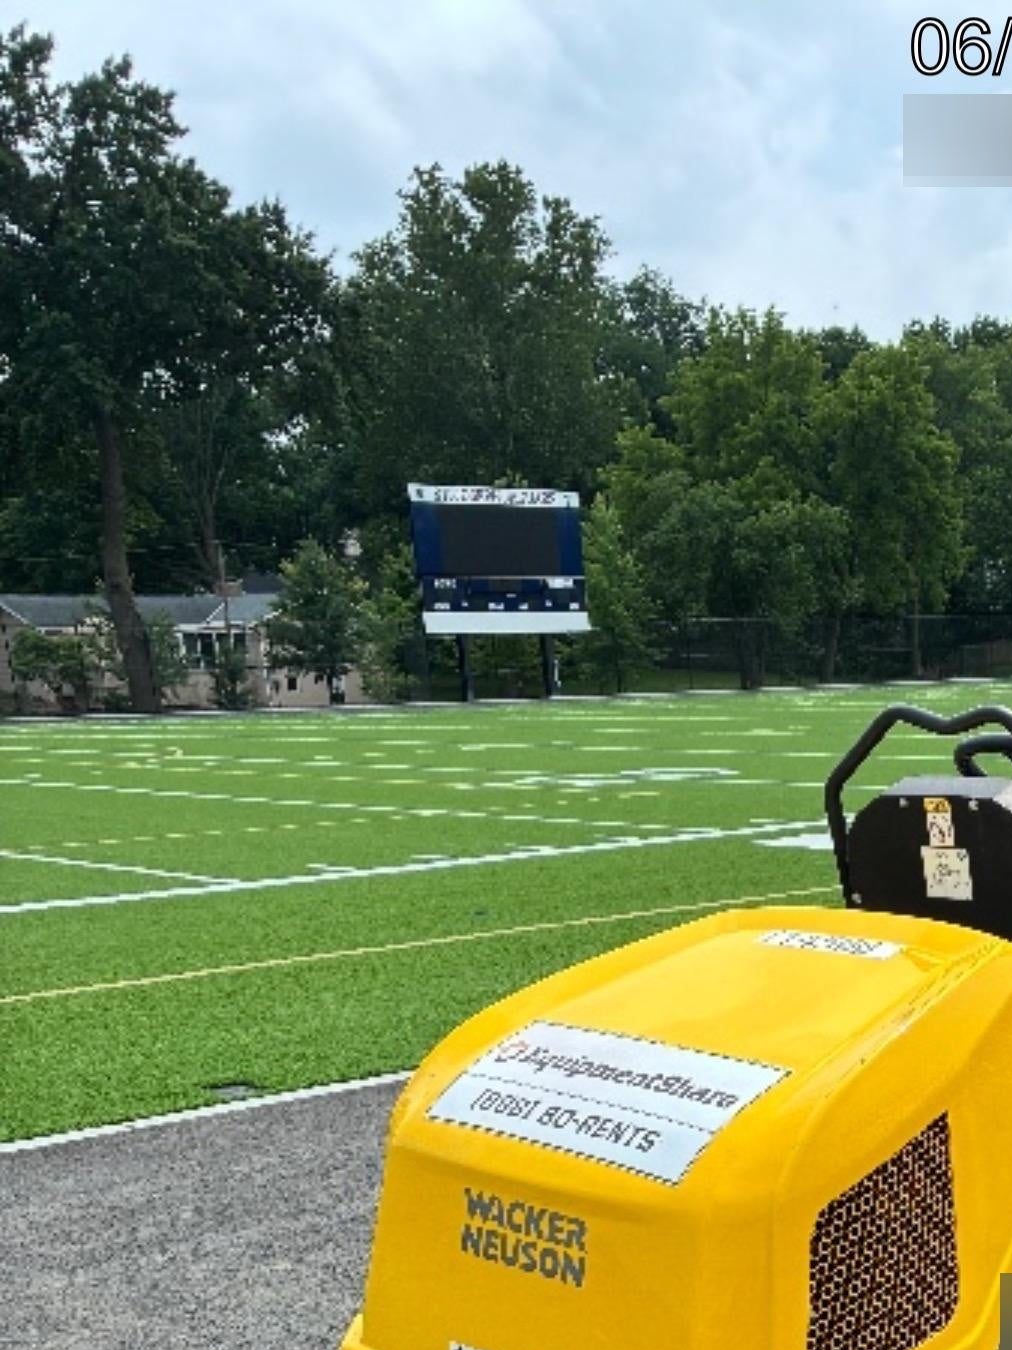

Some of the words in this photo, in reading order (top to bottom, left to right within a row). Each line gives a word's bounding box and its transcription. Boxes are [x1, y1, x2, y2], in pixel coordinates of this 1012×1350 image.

[518, 1046, 740, 1109] EquipmentShare
[536, 1106, 661, 1153] 80-RENTS
[463, 1187, 588, 1251] WACKER
[461, 1223, 586, 1288] NEUSON
